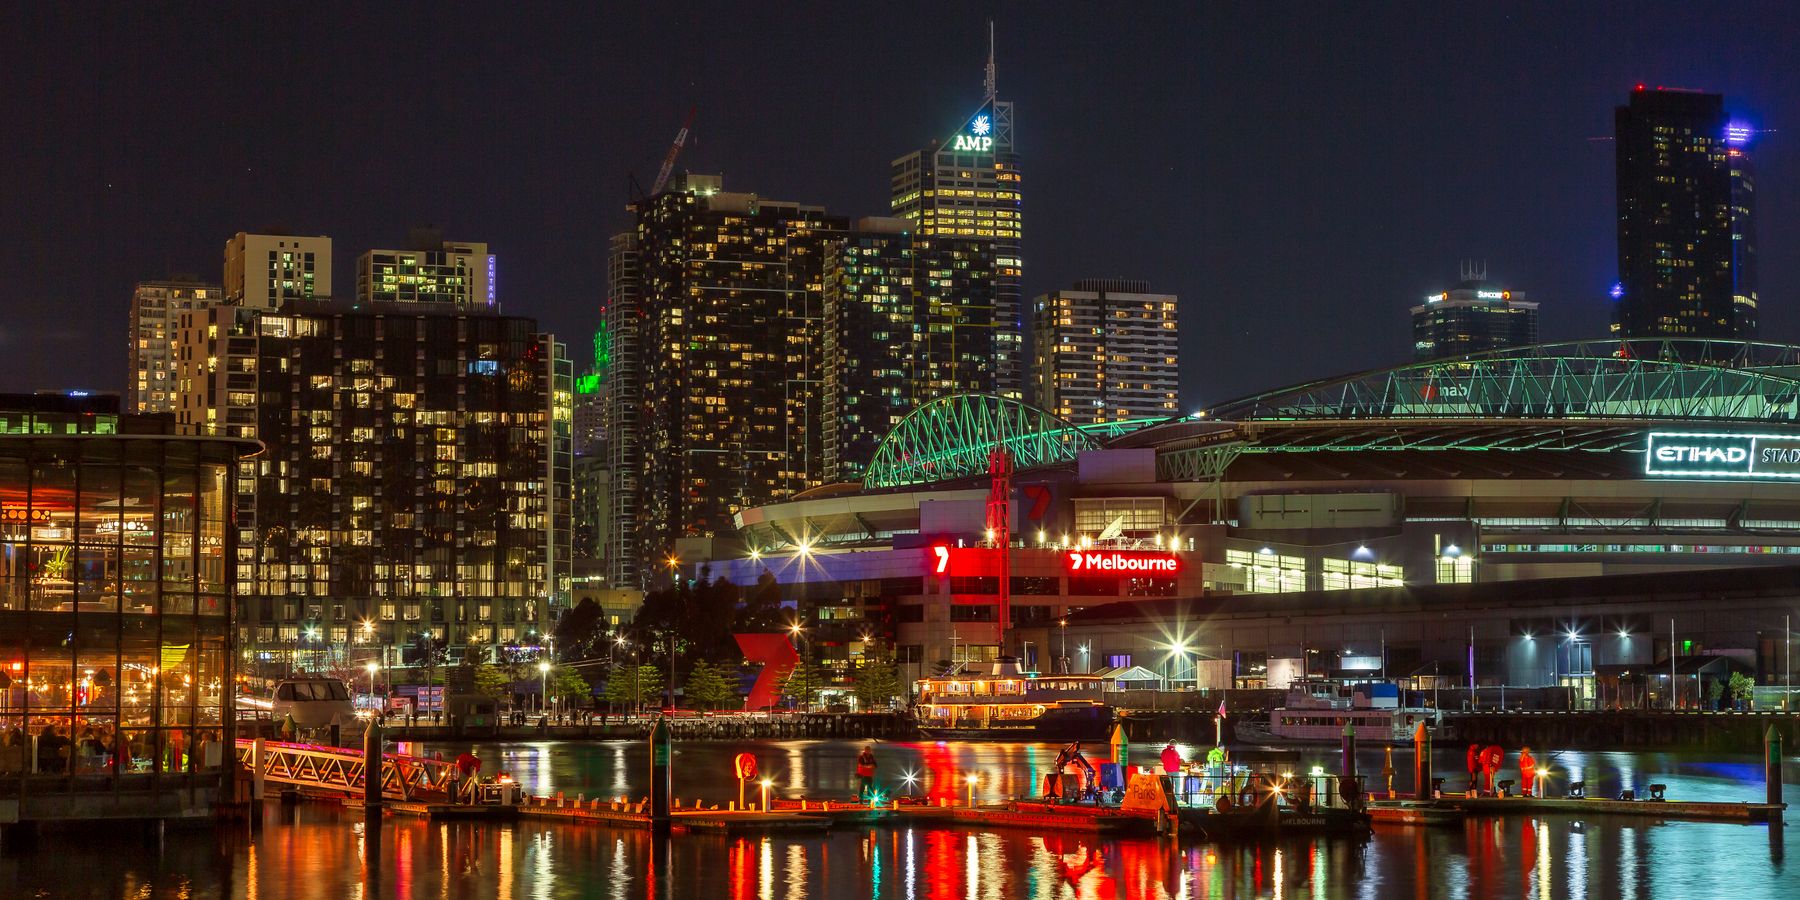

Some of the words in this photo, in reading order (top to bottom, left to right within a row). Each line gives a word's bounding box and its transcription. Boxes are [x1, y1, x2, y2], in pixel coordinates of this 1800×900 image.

[954, 135, 992, 151] AMP
[1439, 383, 1467, 397] nab
[1656, 446, 1747, 463] ETIHAD
[1023, 485, 1052, 520] 7
[934, 546, 949, 573] 7
[1070, 554, 1084, 570] 7
[1086, 553, 1177, 571] Melbourne
[1133, 784, 1156, 801] Parks
